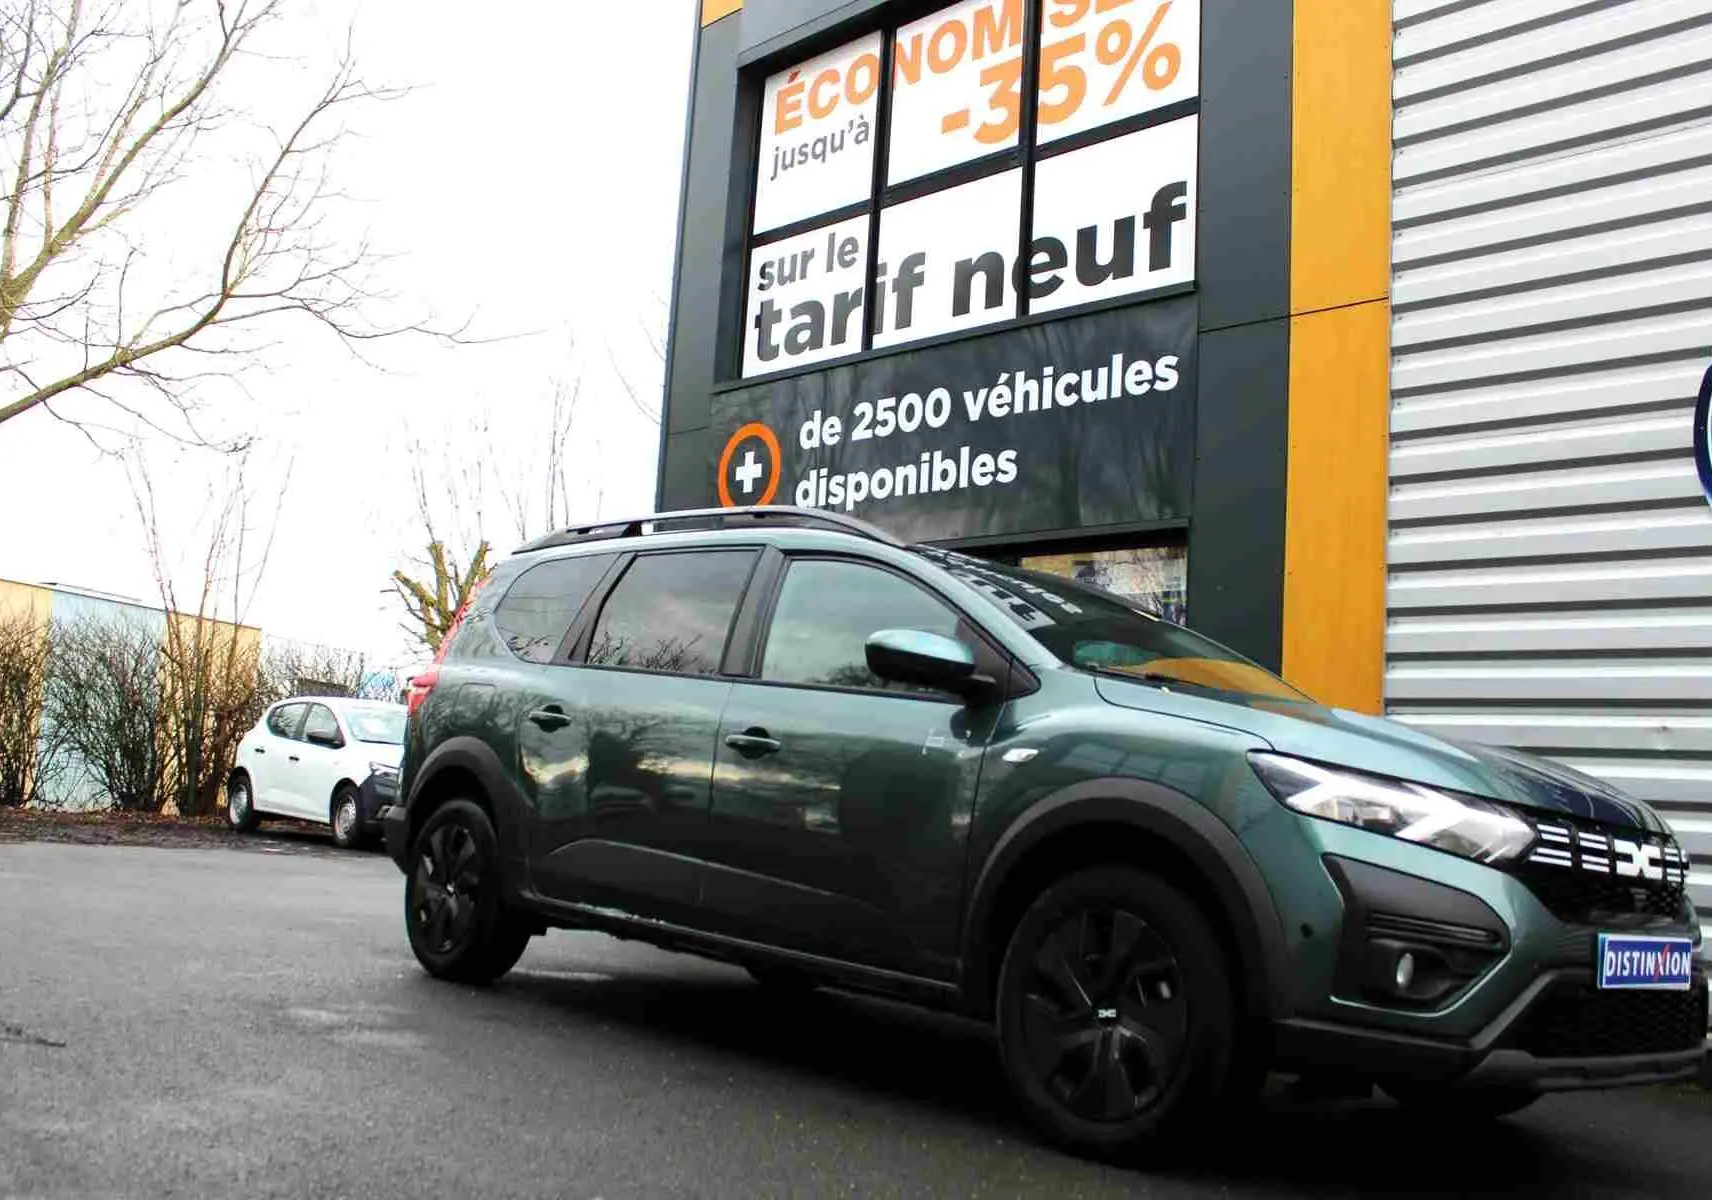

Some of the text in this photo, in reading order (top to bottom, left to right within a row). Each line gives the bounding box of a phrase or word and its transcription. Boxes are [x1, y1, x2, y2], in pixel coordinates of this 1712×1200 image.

[770, 1, 1182, 181] jusqu'à -35%
[754, 180, 1188, 362] tarif neuf
[757, 232, 859, 291] sur le
[799, 353, 1180, 450] de 2500 véhicules
[795, 446, 1018, 512] disponibles
[1606, 948, 1691, 980] DISTINXION
